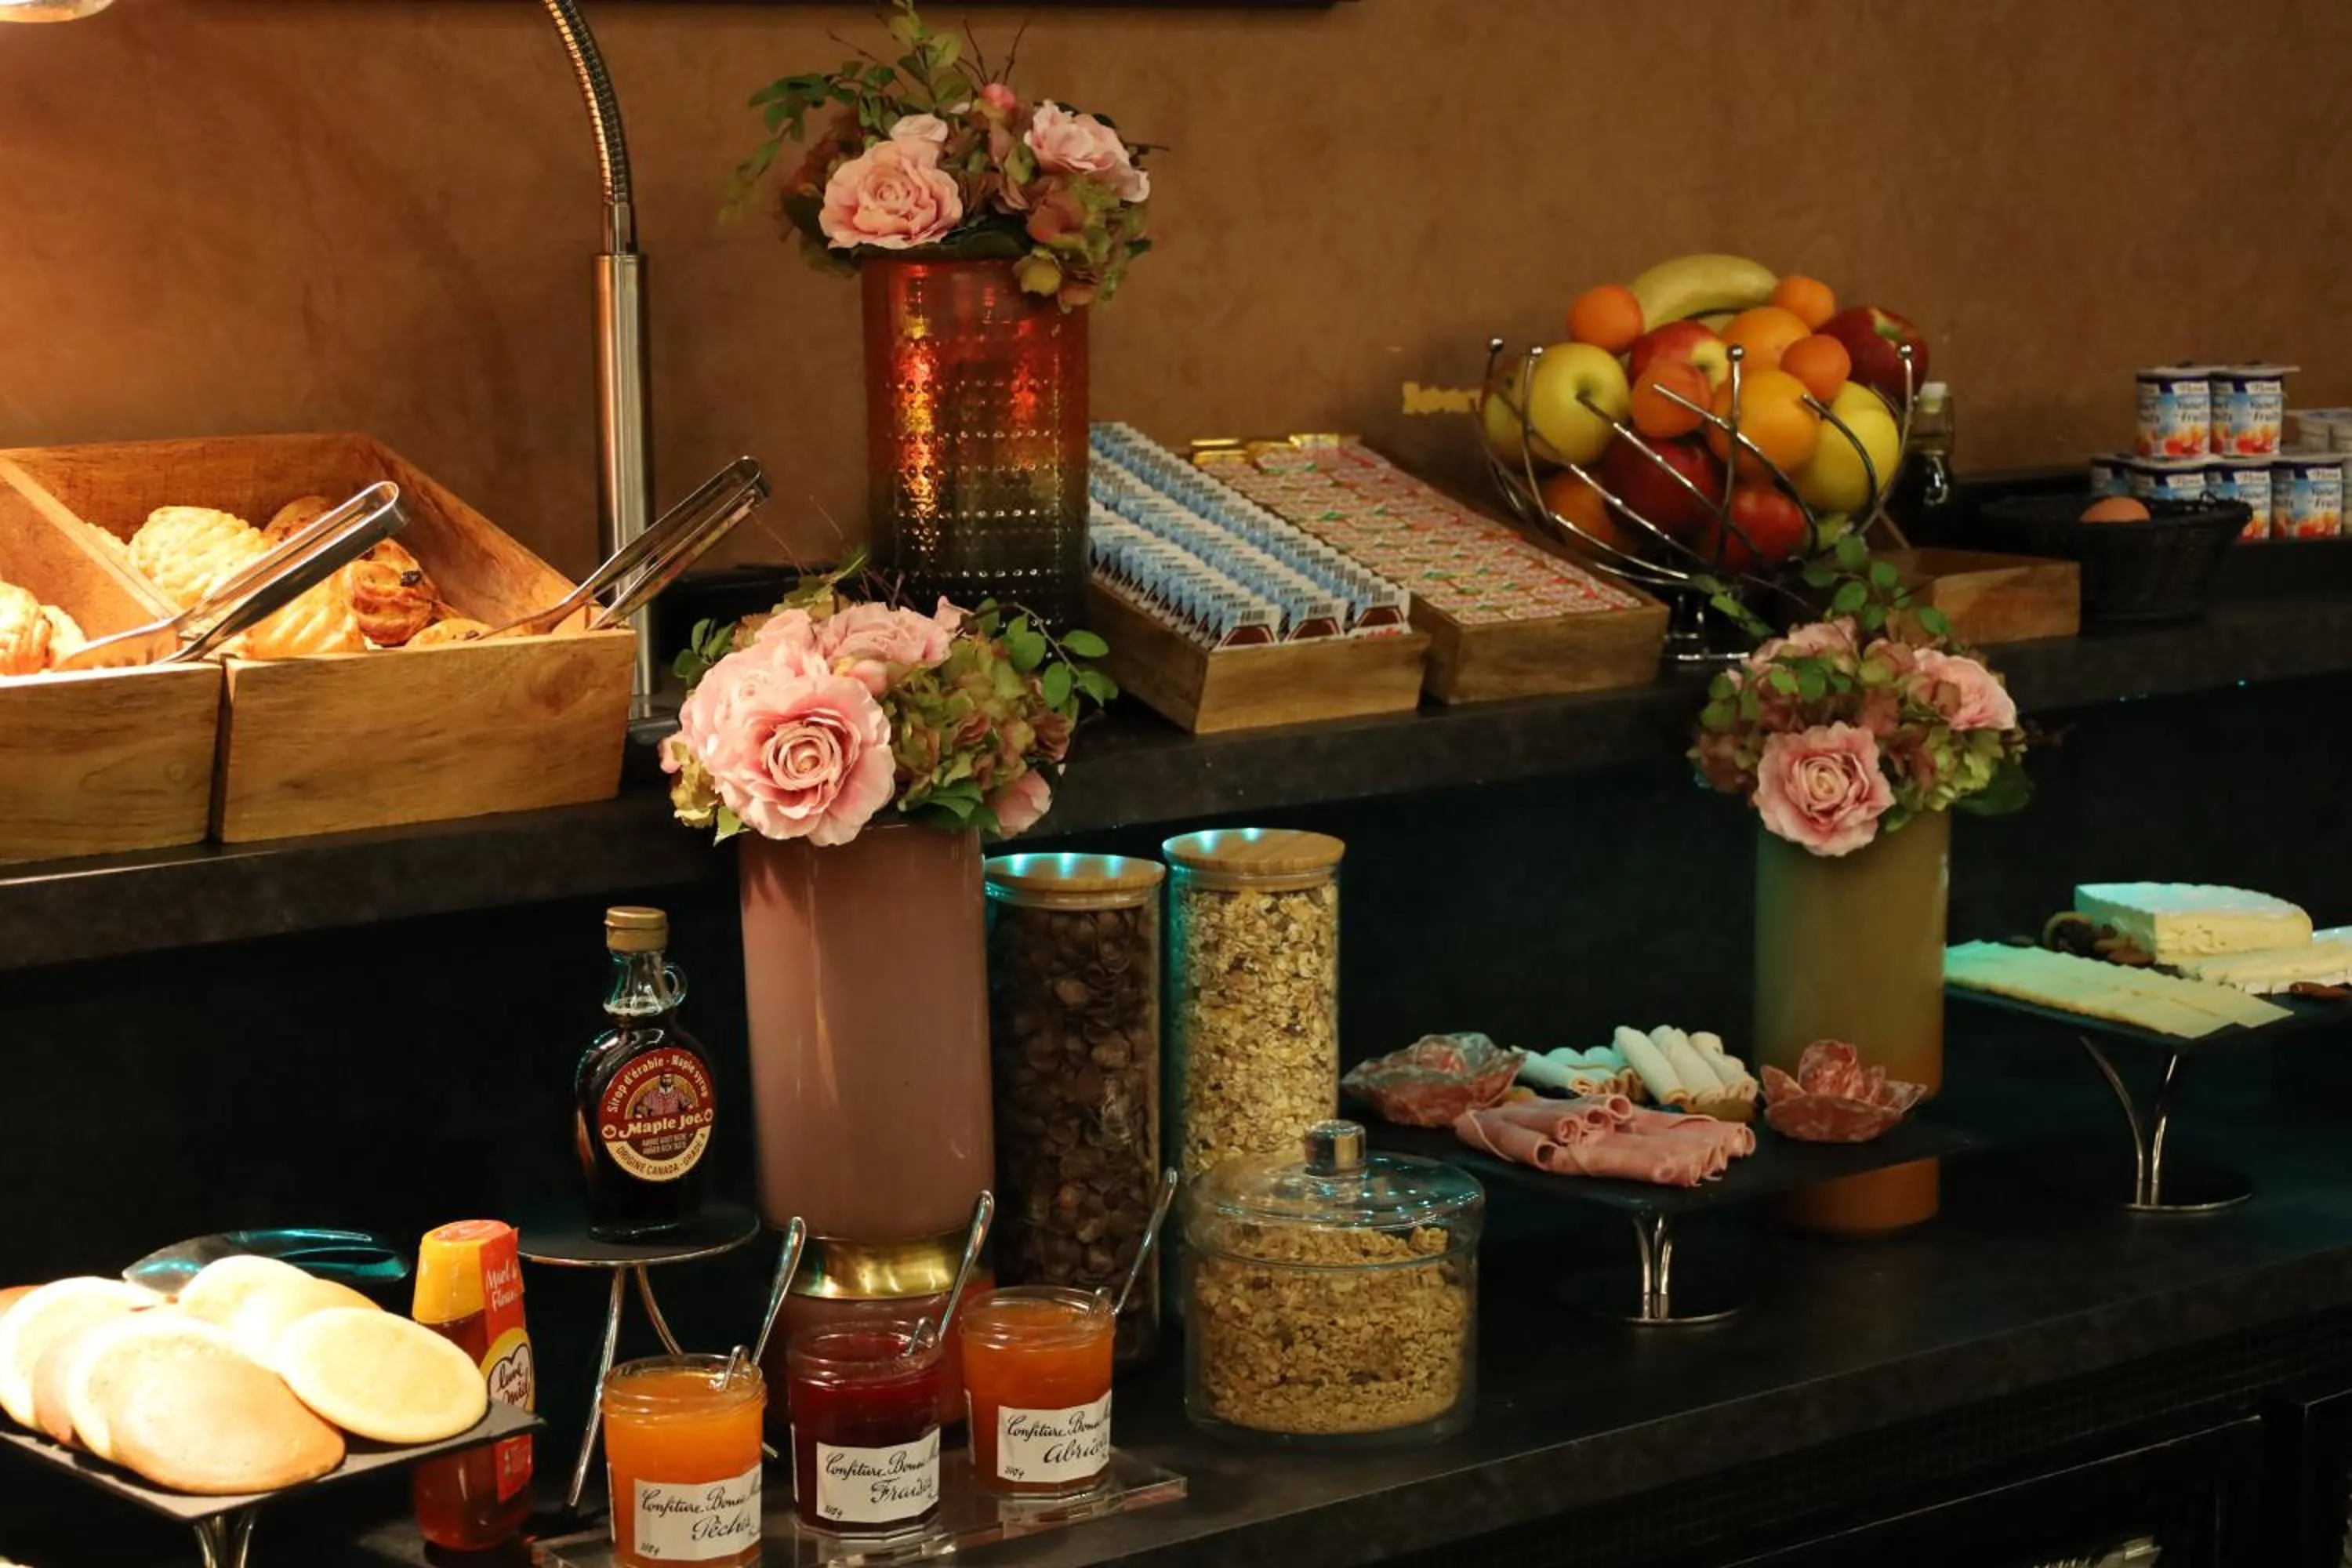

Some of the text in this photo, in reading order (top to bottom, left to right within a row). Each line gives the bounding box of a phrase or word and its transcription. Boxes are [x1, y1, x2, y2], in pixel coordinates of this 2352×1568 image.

[606, 1084, 627, 1112] Sirop
[624, 1057, 664, 1086] d'érable
[618, 1118, 677, 1138] Maple
[615, 1145, 646, 1173] ORIGINE
[647, 1163, 679, 1175] CANADA
[1007, 1414, 1066, 1443] Confiture
[826, 1453, 886, 1481] Confiture
[641, 1488, 702, 1518] Confiture
